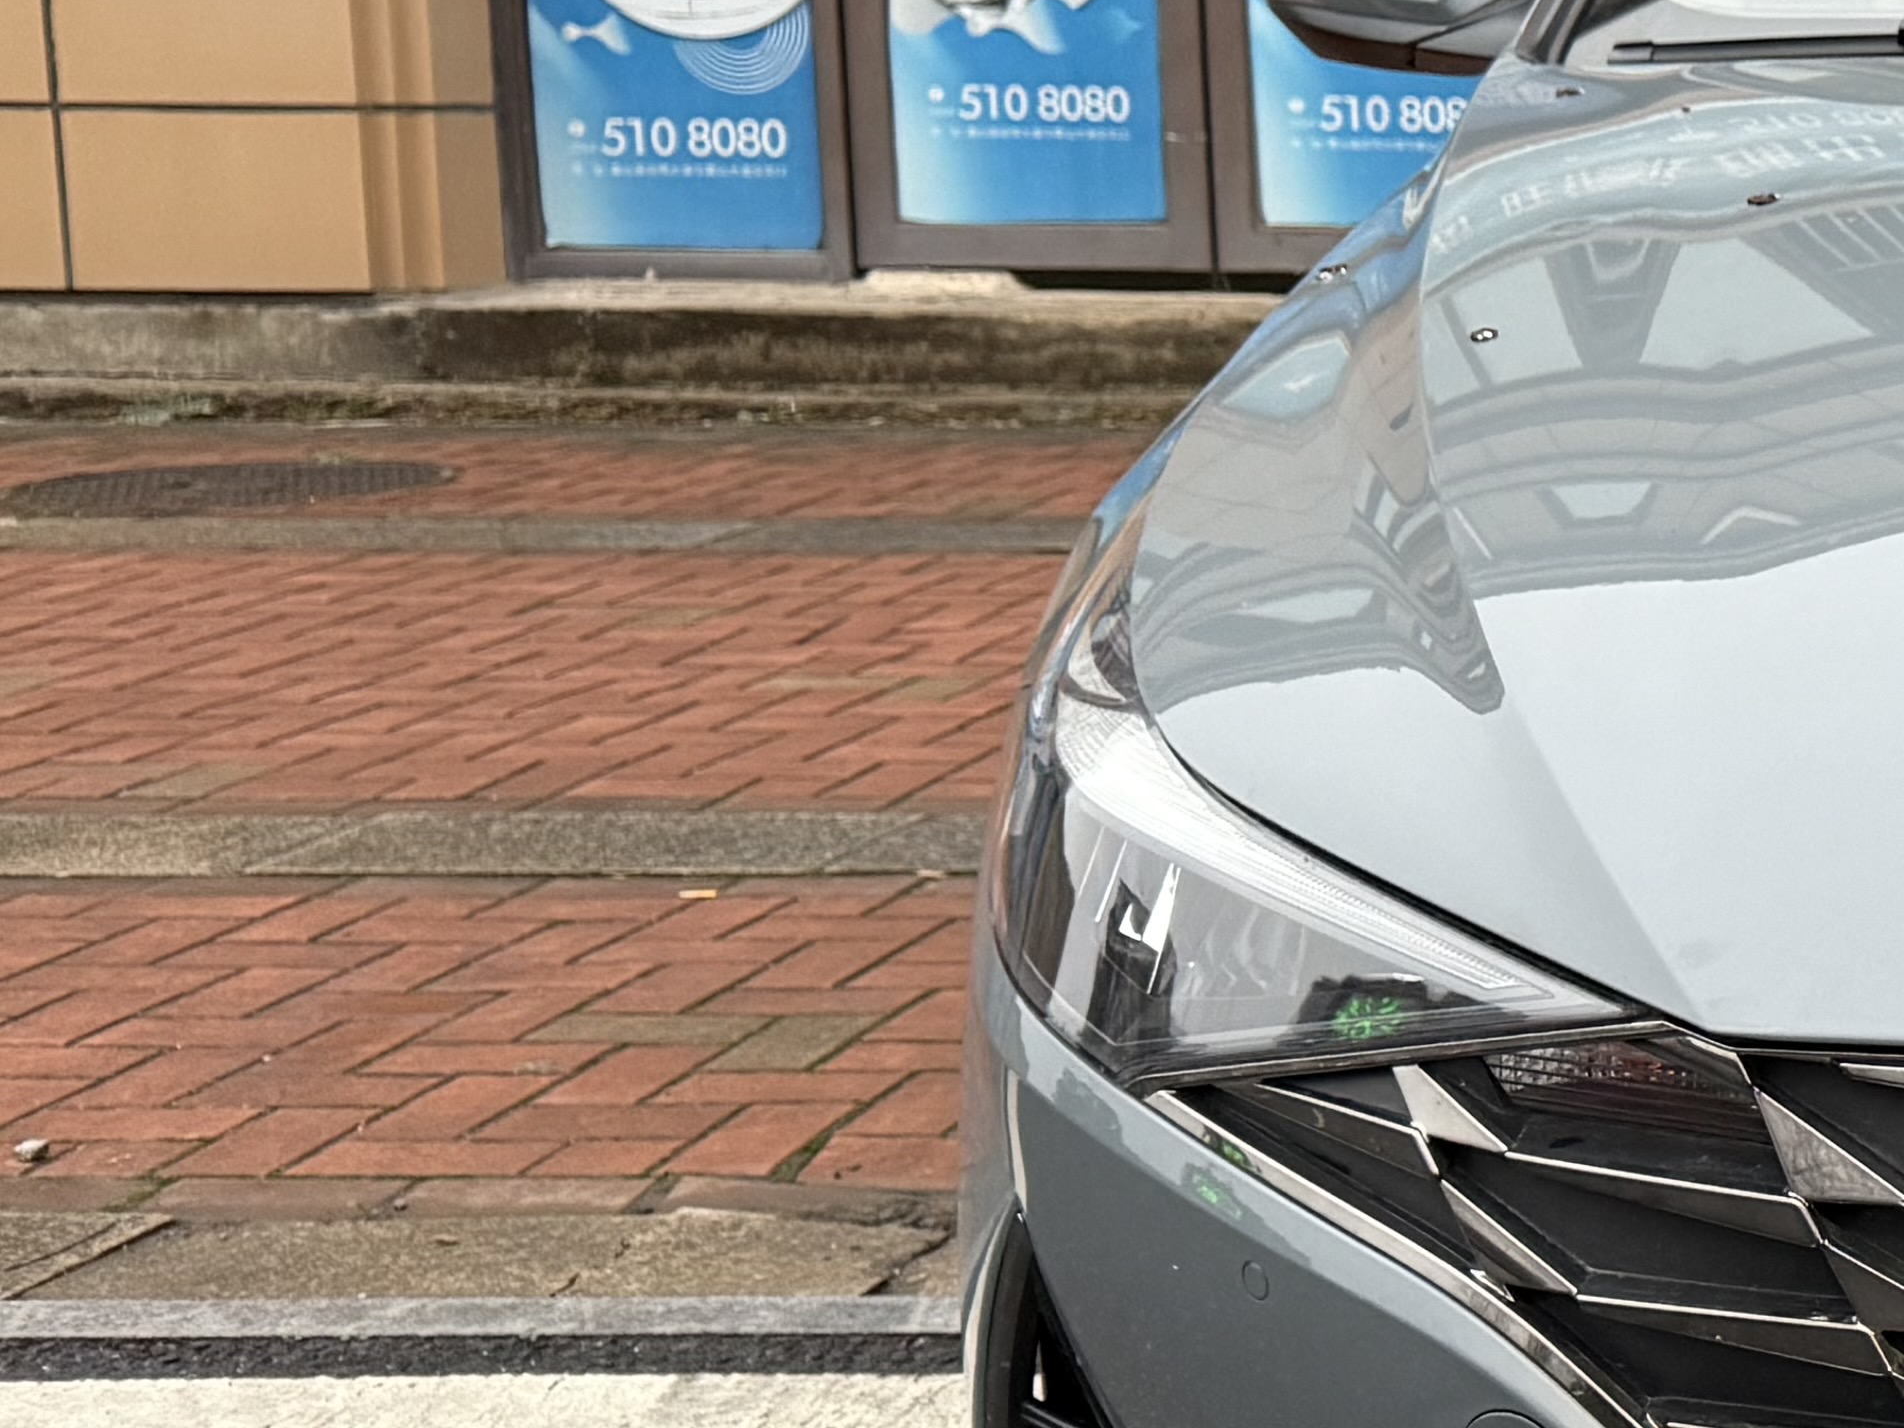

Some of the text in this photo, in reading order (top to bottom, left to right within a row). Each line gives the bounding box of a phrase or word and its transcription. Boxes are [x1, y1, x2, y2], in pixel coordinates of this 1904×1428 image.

[958, 82, 1131, 124] 510 8080
[1318, 94, 1391, 133] 510
[601, 116, 788, 160] 510 8080
